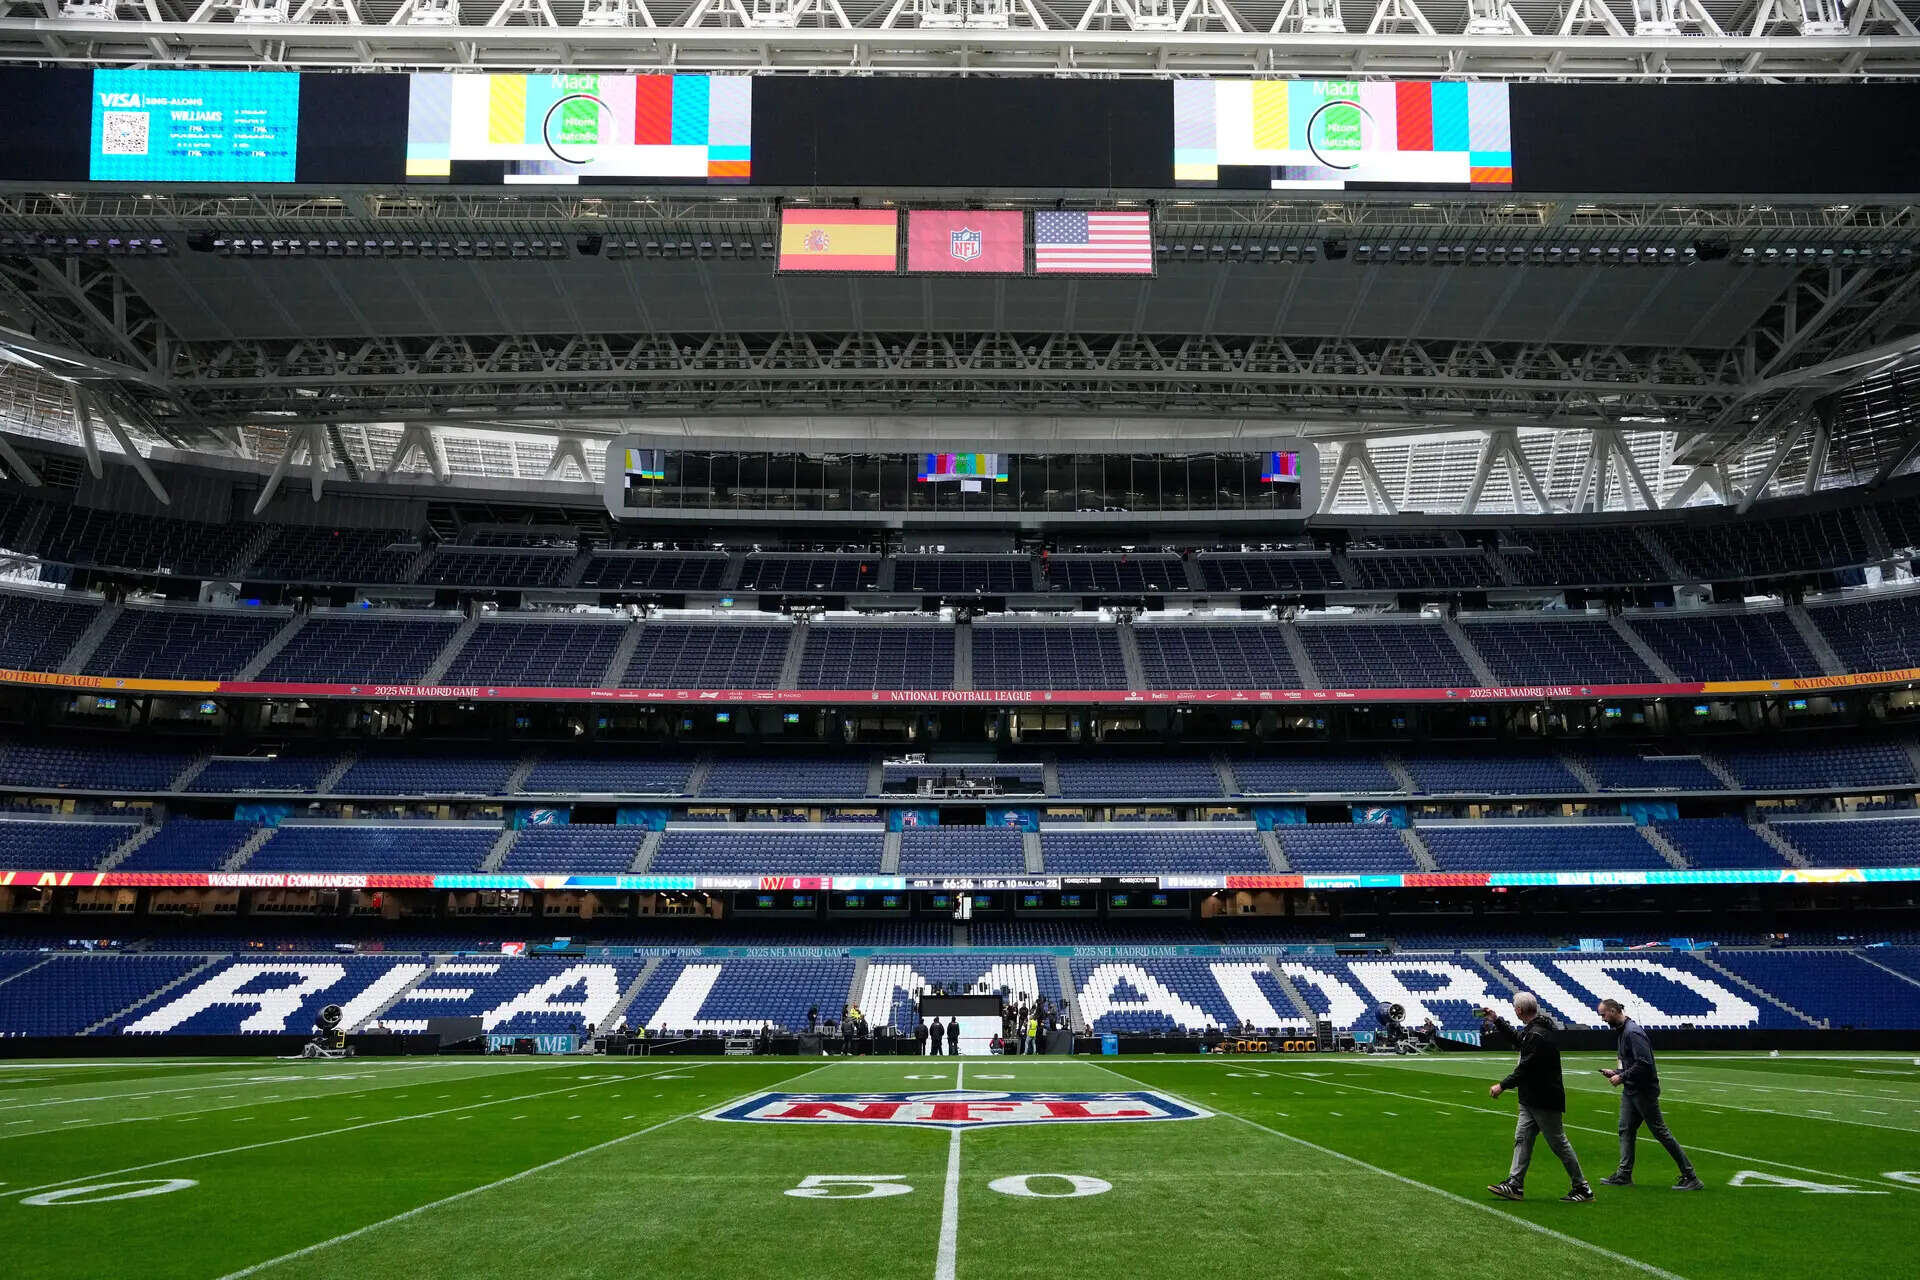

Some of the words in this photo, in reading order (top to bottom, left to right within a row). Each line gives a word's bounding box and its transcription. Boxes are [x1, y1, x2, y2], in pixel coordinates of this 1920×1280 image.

[99, 93, 141, 107] VISA
[171, 111, 223, 122] WILLIAMS
[953, 241, 979, 256] NFL
[55, 675, 101, 687] LEAGUE
[1792, 675, 1849, 690] NATIONAL
[1853, 670, 1914, 685] FOOTBALL
[374, 686, 397, 696] 2025
[399, 686, 416, 696] NFL
[416, 687, 452, 697] MADRID
[453, 687, 480, 697] GAME
[891, 691, 939, 701] NATIONAL
[942, 691, 992, 701] FOOTBALL
[995, 691, 1032, 701] LEAGUE
[1469, 689, 1492, 698] 2025
[1492, 688, 1510, 698] NFL
[1510, 688, 1544, 697] MADRID
[1546, 687, 1572, 696] GAME
[207, 874, 285, 887] WASHINGTON
[287, 875, 367, 887] COMMANDERS
[714, 878, 752, 888] NetApp
[793, 878, 800, 888] 0
[913, 880, 927, 888] QTR
[930, 880, 934, 888] 1
[943, 878, 973, 889] 66:36
[982, 880, 998, 888] 1ST
[1006, 880, 1016, 888] 10
[1181, 878, 1217, 887] NetApp
[634, 948, 659, 957] MIAMI
[746, 948, 768, 957] 2025
[770, 948, 786, 957] NFL
[788, 948, 823, 957] MADRID
[824, 948, 850, 957] GAME
[1074, 947, 1097, 957] 2025
[1097, 947, 1114, 957] NFL
[1115, 947, 1149, 957] MADRID
[1151, 947, 1177, 956] GAME
[1220, 947, 1246, 955] MIAMI
[1248, 947, 1288, 955] DOLPHINS
[123, 962, 774, 1035] REAL
[857, 959, 1760, 1034] MADRID
[763, 1100, 1152, 1121] NFL
